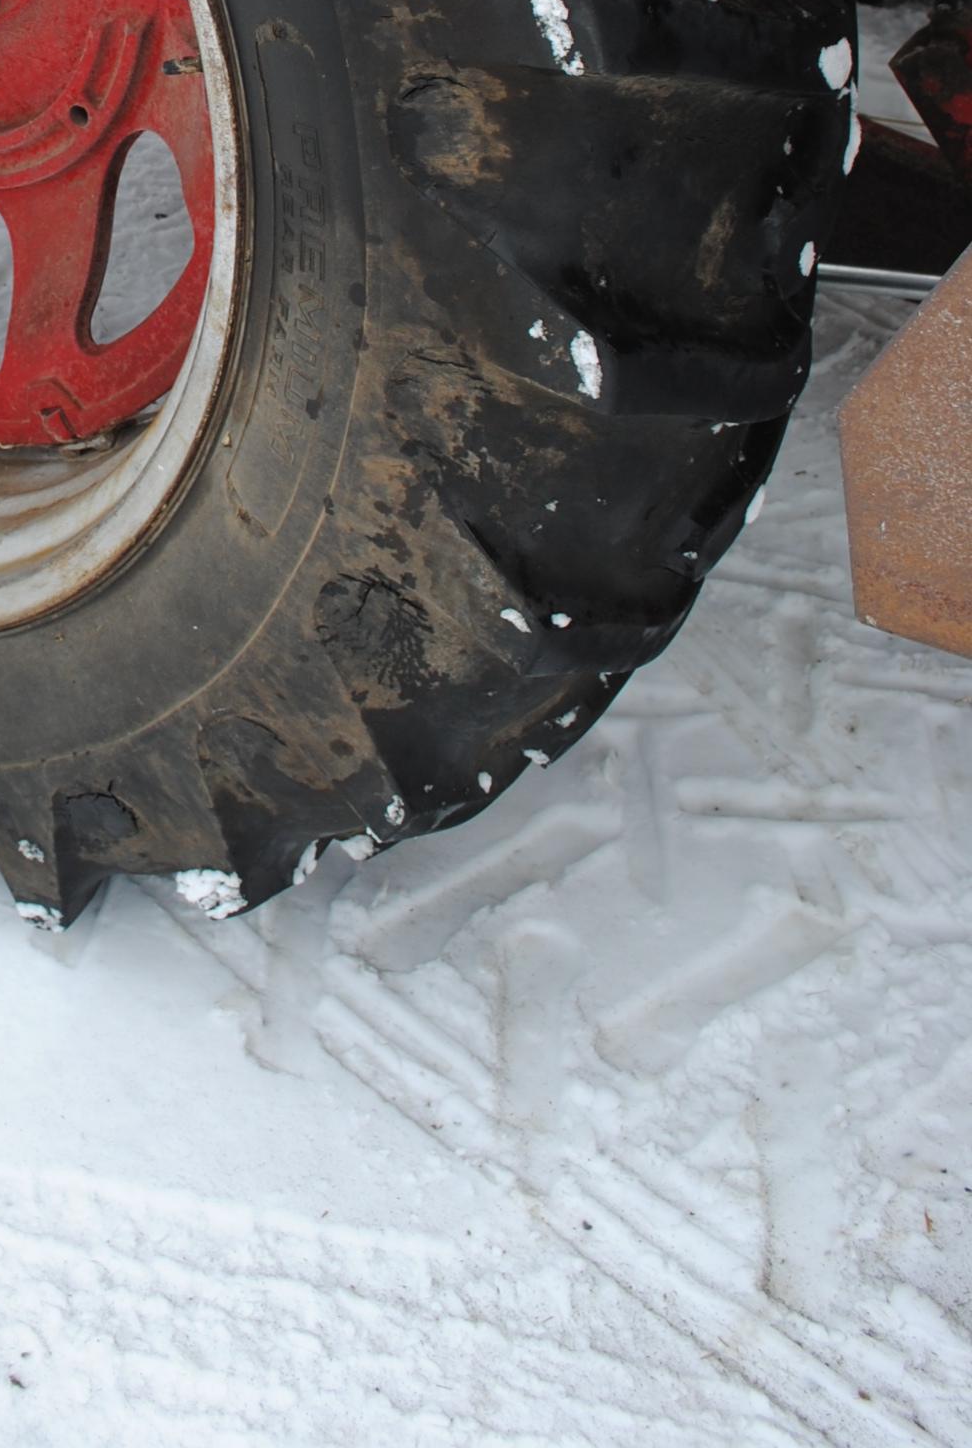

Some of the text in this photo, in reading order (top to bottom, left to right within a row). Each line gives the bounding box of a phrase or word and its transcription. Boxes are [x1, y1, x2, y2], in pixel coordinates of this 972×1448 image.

[266, 163, 293, 399] REAR FARM
[268, 121, 327, 465] PREMIUM
